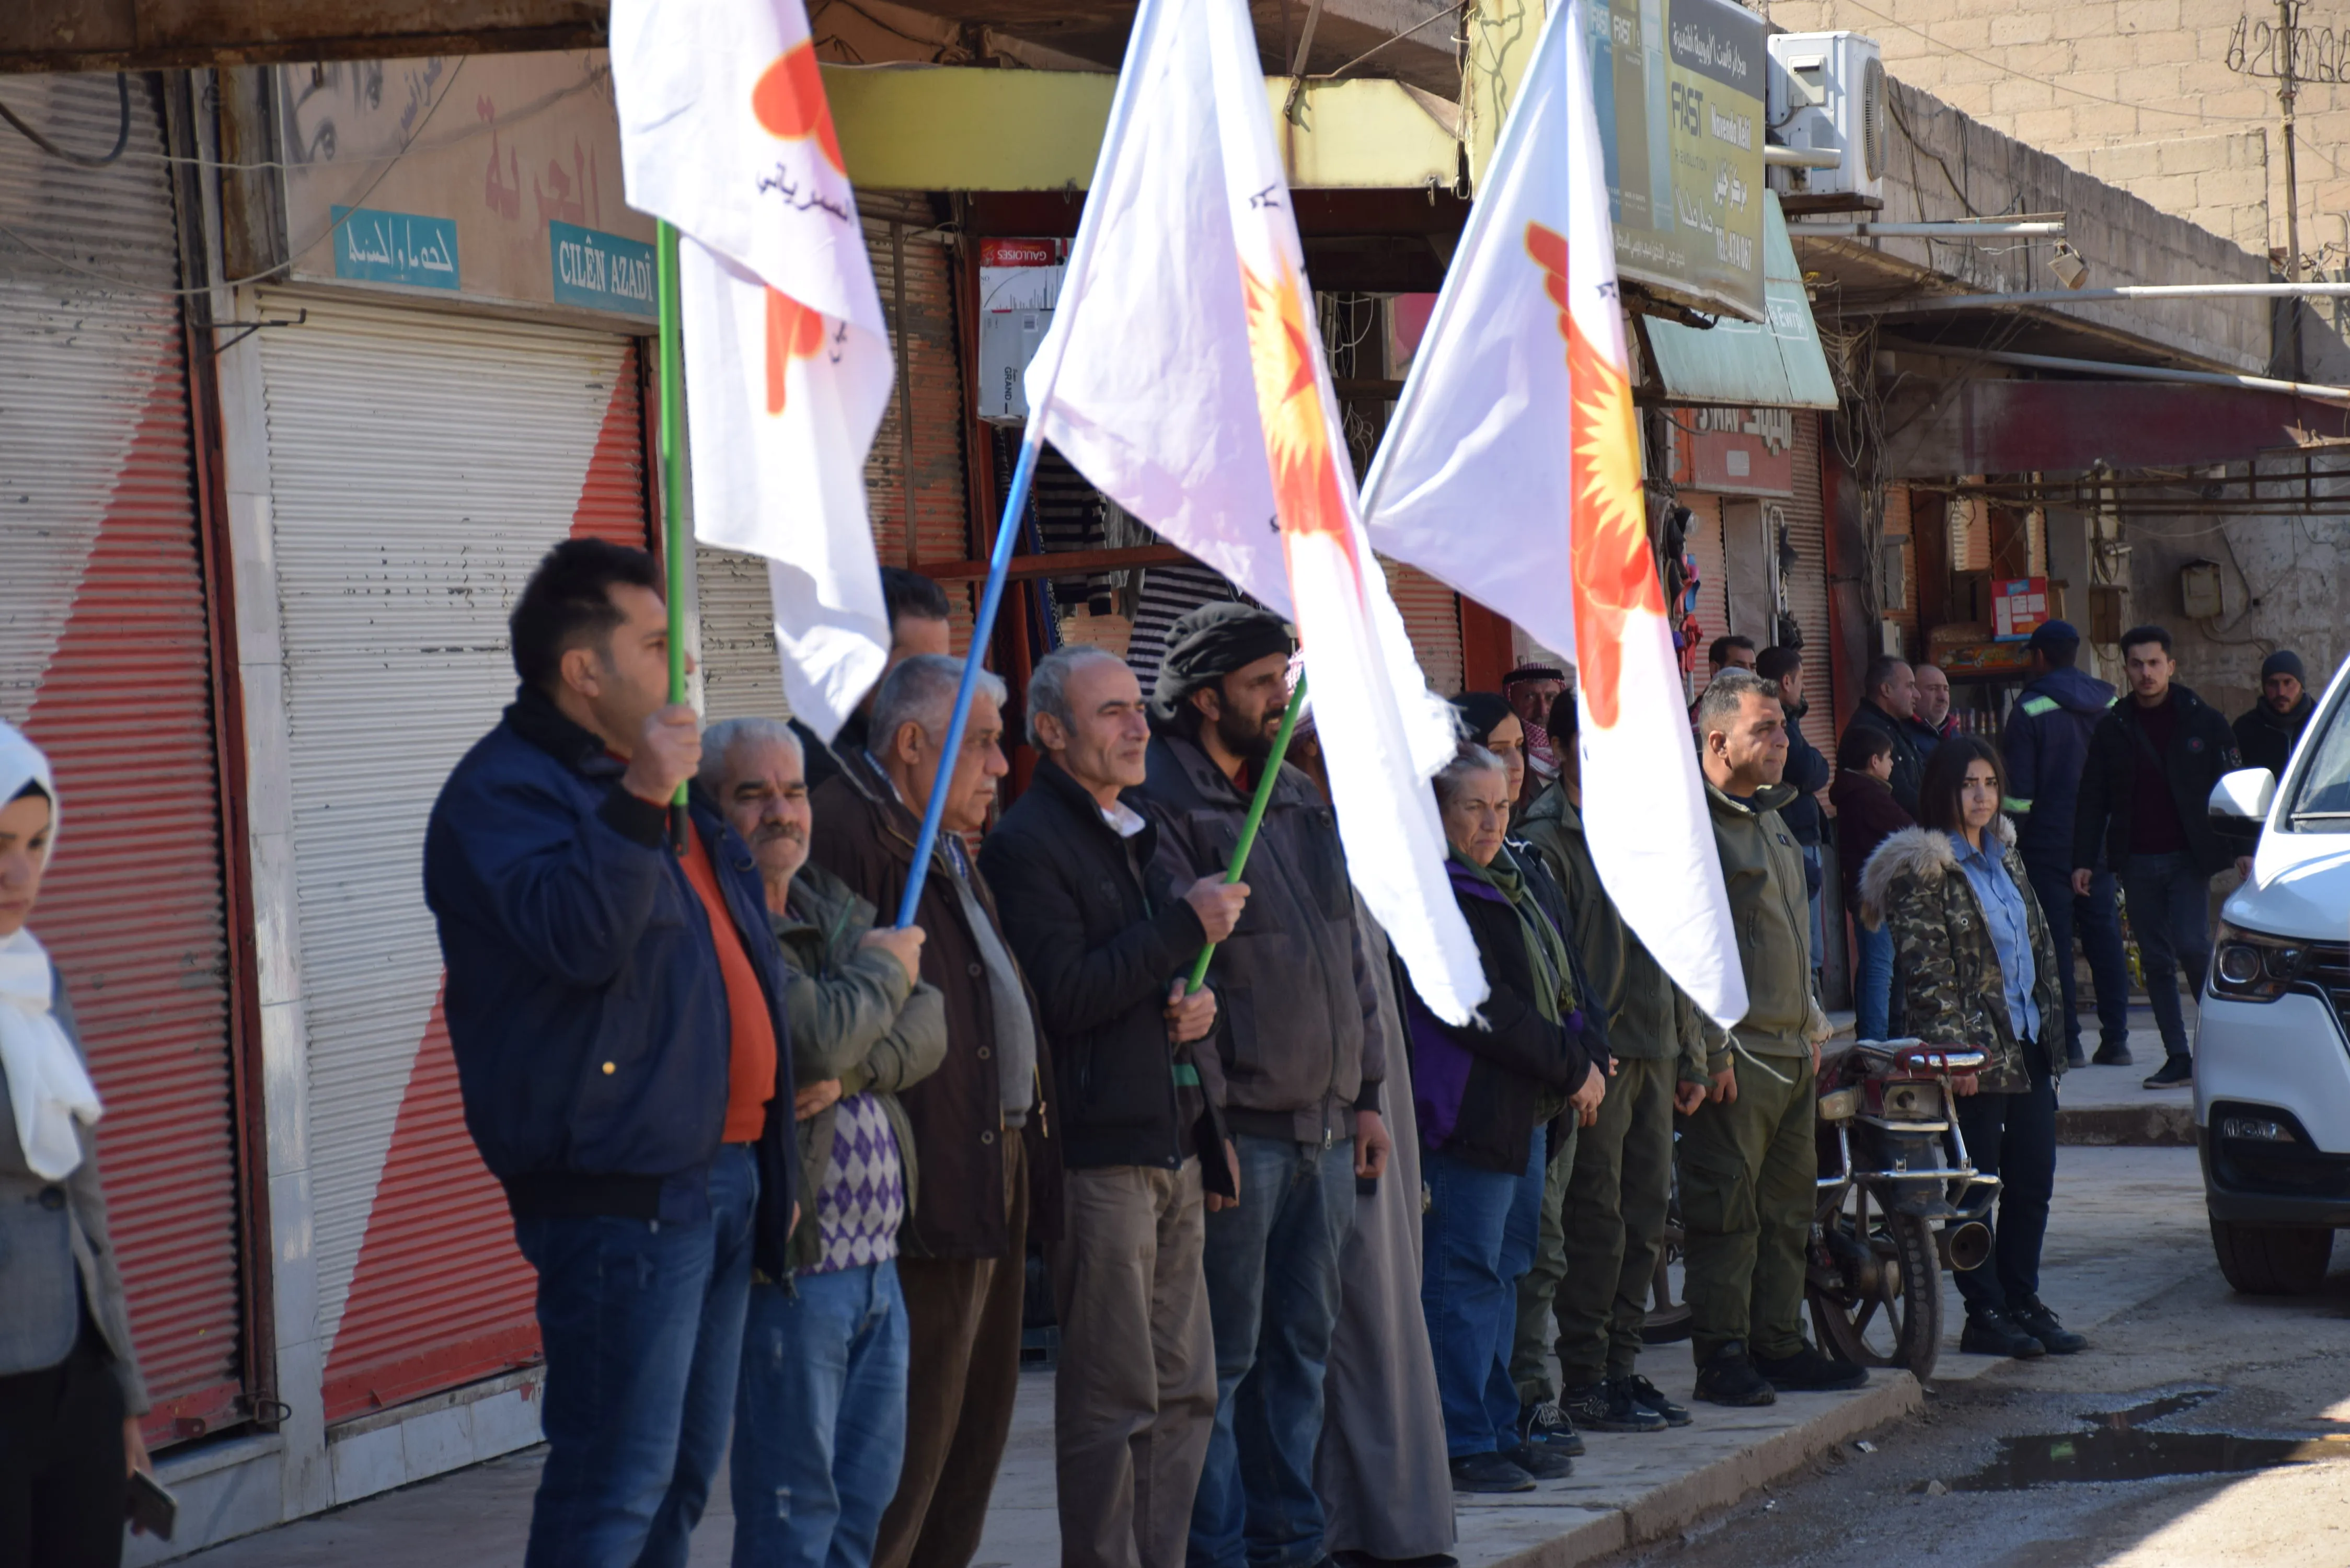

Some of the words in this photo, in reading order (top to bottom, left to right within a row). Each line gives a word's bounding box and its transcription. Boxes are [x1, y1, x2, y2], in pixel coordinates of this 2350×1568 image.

[1614, 15, 1631, 45] FAST
[1672, 81, 1703, 138] FAST
[1711, 102, 1737, 145] Navenda
[1714, 157, 1729, 205] خليل
[1730, 163, 1747, 213] مركز
[997, 249, 1047, 261] GAULOISES
[1715, 226, 1728, 263] TEL:
[559, 234, 606, 293] CILÊN
[611, 250, 653, 302] AZADÎ
